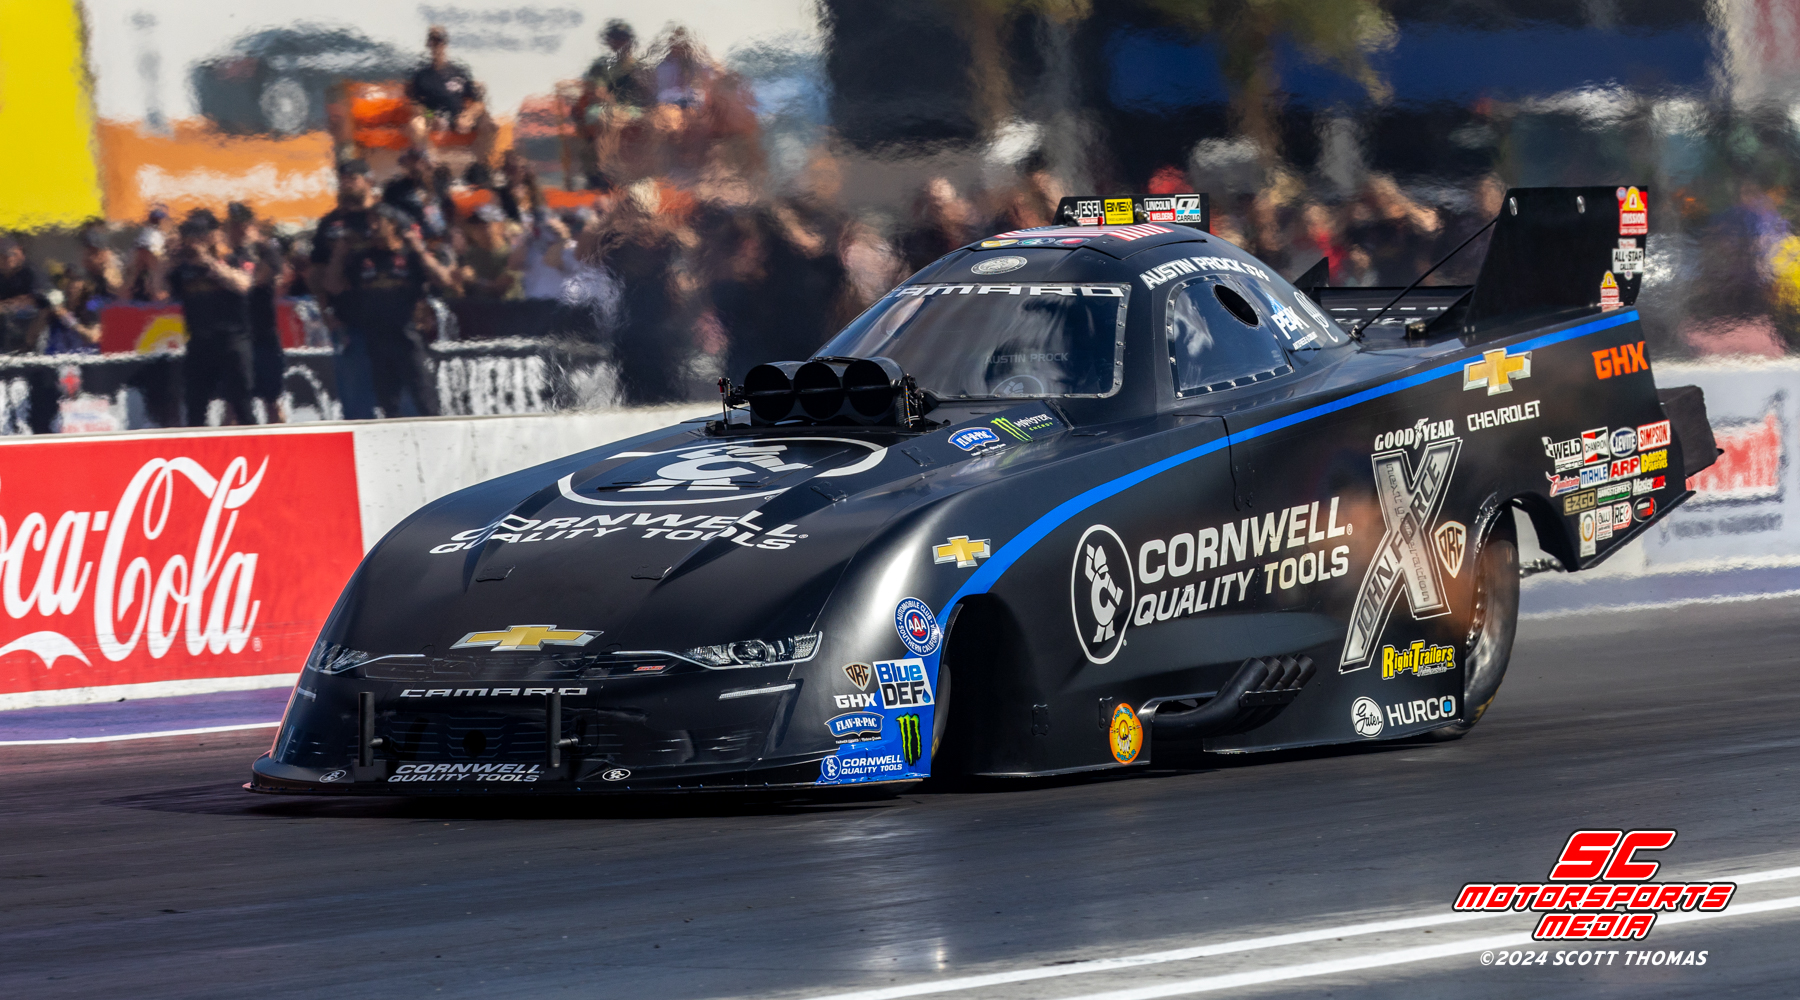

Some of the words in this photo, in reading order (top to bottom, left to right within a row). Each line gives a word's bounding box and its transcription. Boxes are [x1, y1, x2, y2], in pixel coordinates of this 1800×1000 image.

[1075, 201, 1103, 217] JESEL
[1146, 201, 1171, 210] LINCOLN
[1152, 211, 1175, 220] WELDERS
[1177, 214, 1201, 222] CARRILLO
[1139, 258, 1199, 290] AUSTIN
[1190, 256, 1249, 274] PROCK
[1271, 306, 1310, 340] PEAK
[985, 353, 1026, 365] AUSTIN
[1031, 352, 1069, 363] PROCK
[1592, 341, 1649, 380] GHX
[1014, 413, 1053, 428] MONSTER
[1467, 400, 1541, 432] CHEVROLET
[1028, 422, 1054, 431] ENERGY
[1639, 424, 1668, 447] SIMPSON
[1553, 438, 1582, 459] WELD
[1585, 437, 1607, 452] CHAMPION
[1581, 466, 1607, 485] MAHLE
[1610, 457, 1640, 478] ARP
[451, 510, 801, 542] CORNWELL
[429, 526, 629, 554] QUALITY
[641, 527, 797, 550] TOOLS
[1138, 496, 1346, 584] CORNWELL
[0, 454, 269, 661] ca-Cola
[1134, 568, 1255, 626] QUALITY
[1264, 545, 1350, 594] TOOLS
[897, 600, 920, 622] AUTOMOBILE
[920, 605, 933, 621] CLUB
[1356, 556, 1397, 650] JOHN
[908, 618, 927, 632] AAA
[898, 625, 922, 653] SOUTHERN
[922, 624, 939, 653] CALIFORNIA
[875, 663, 923, 683] Blue
[400, 687, 588, 698] CAMARO
[833, 693, 878, 709] GHX
[880, 680, 925, 706] DEF
[1386, 695, 1456, 727] HURCO
[835, 717, 877, 732] FLAV-R-PAC
[395, 763, 543, 774] CORNWELL
[841, 766, 877, 775] QUALITY
[880, 764, 903, 772] TOOLS
[842, 755, 903, 768] CORNWELL
[387, 773, 467, 783] QUALITY
[475, 773, 541, 783] TOOLS
